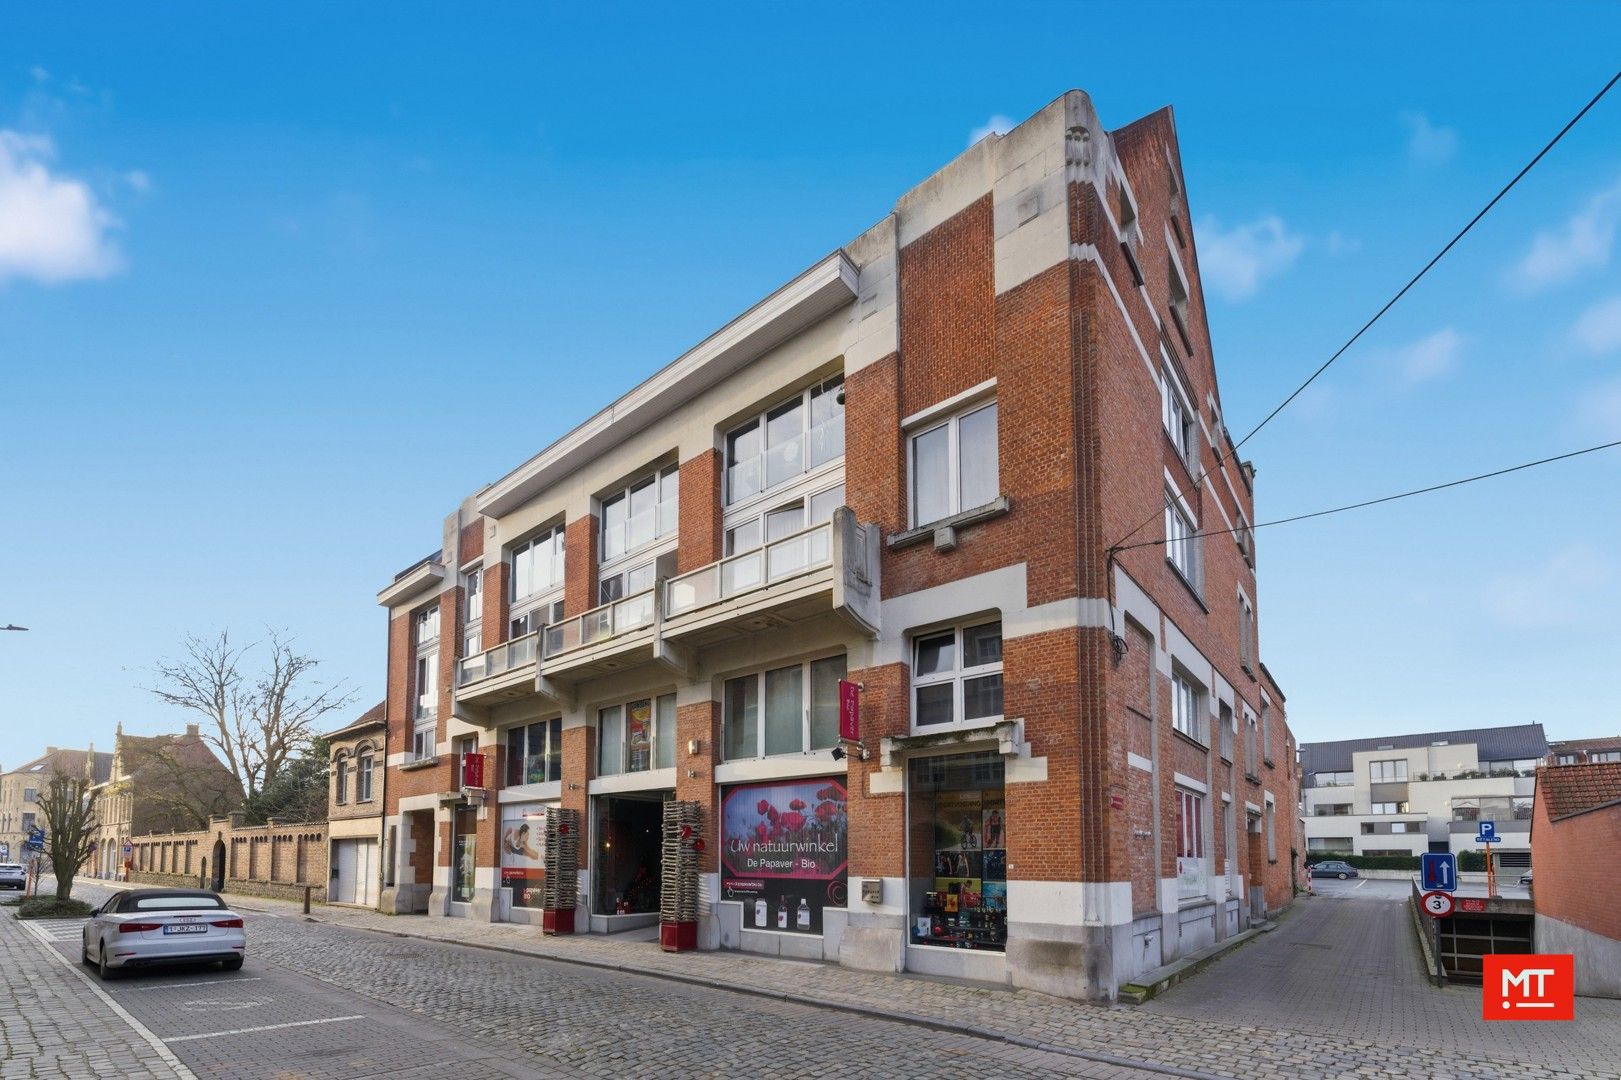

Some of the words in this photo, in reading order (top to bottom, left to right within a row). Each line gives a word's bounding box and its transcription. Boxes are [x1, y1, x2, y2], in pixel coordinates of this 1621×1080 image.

[1481, 823, 1492, 835] P
[730, 839, 750, 852] Uw
[753, 833, 838, 852] natuurwinkel
[747, 858, 758, 867] De
[760, 858, 793, 869] Papaver
[801, 858, 816, 868] Bio
